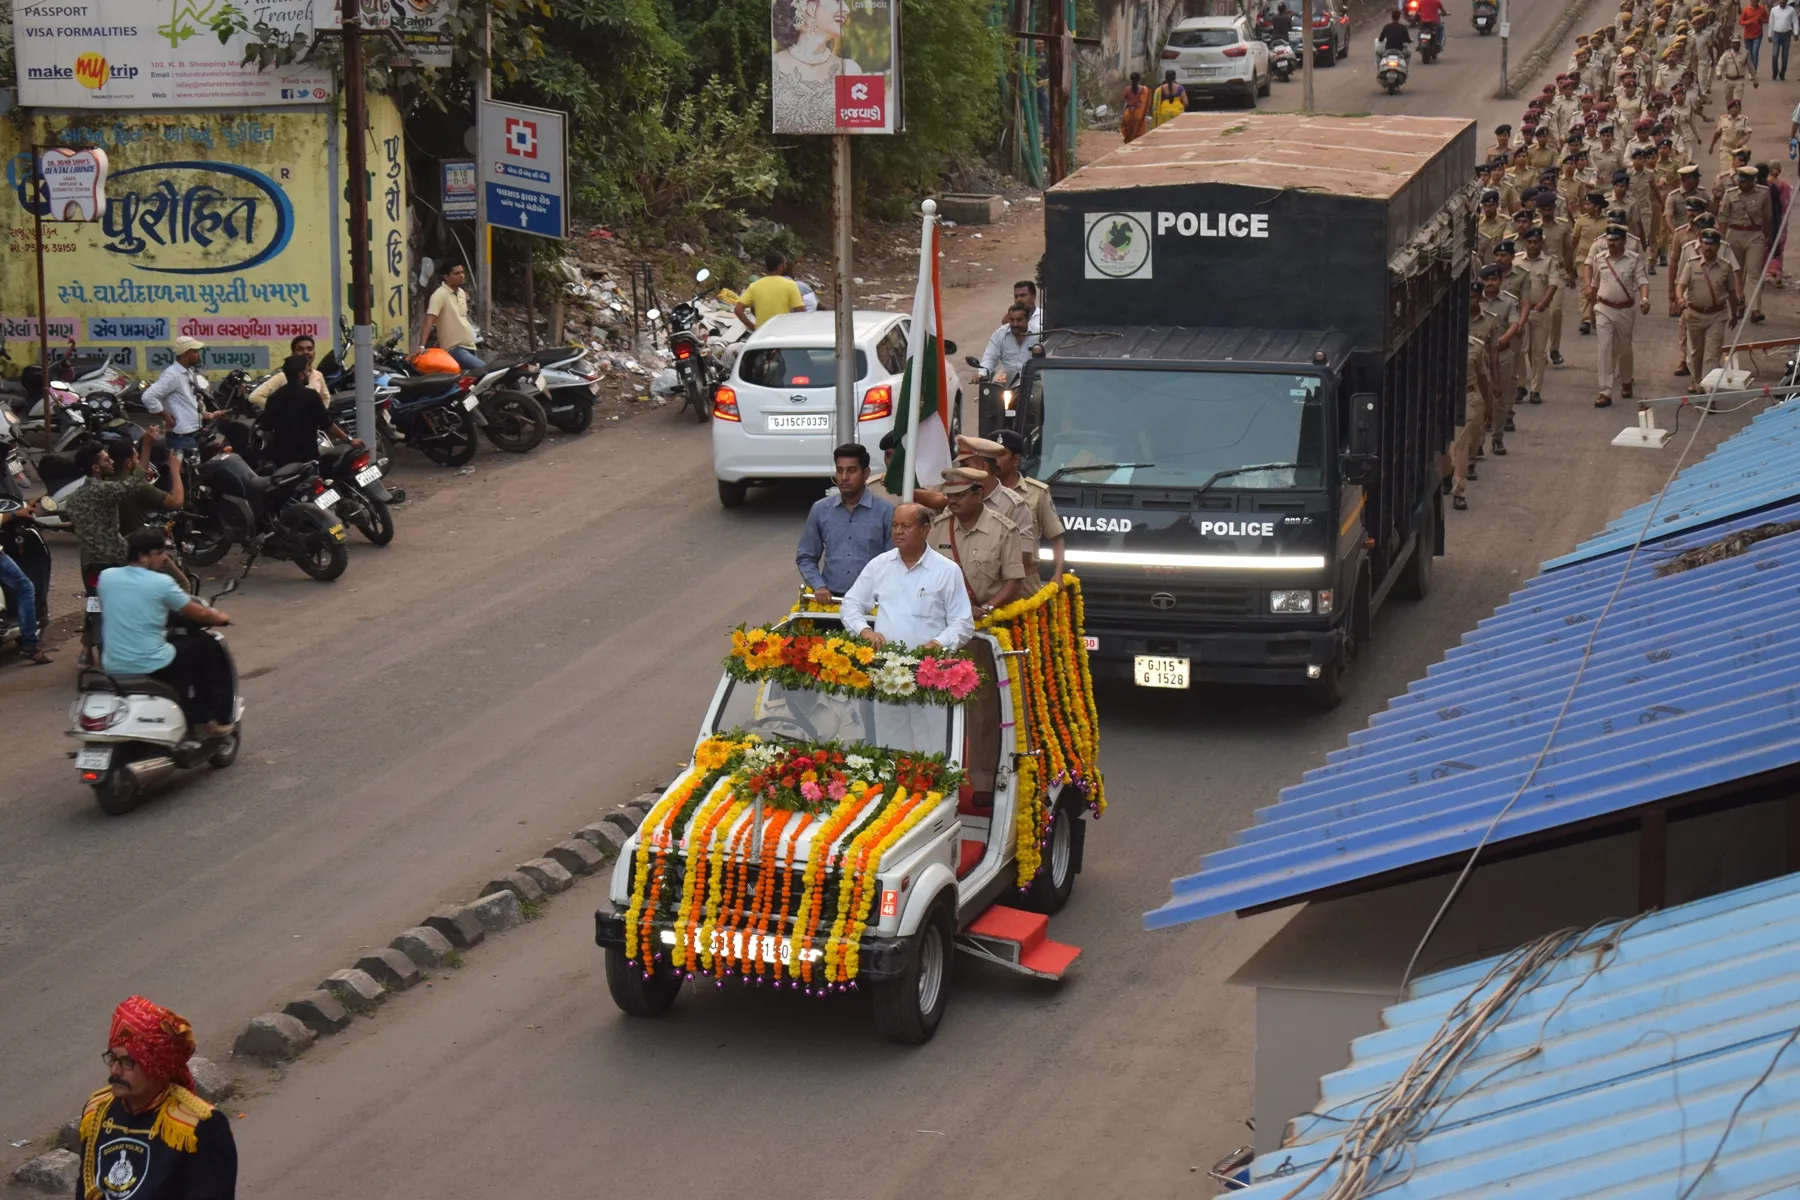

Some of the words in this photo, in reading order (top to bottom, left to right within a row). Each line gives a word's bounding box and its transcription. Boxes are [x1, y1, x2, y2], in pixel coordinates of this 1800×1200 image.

[25, 6, 88, 17] PASSPORT
[26, 27, 54, 37] VISA
[57, 26, 137, 37] FORMALITIES
[189, 61, 226, 69] Shopping
[28, 64, 73, 79] make
[76, 57, 106, 90] my
[110, 64, 139, 79] trip
[45, 166, 69, 174] DENTAL
[69, 165, 95, 173] LOUNGE
[281, 167, 290, 180] R
[496, 188, 520, 199] વલસાડ
[1157, 211, 1269, 238] POLICE
[251, 282, 310, 308] ખમણ
[93, 319, 117, 336] સેવ
[120, 318, 165, 340] ખમણી
[182, 319, 213, 336] તીખા
[217, 319, 271, 339] લસણીયા
[211, 354, 255, 367] ખમણ
[774, 417, 828, 427] GJ15CF0339
[1063, 516, 1132, 532] VALSAD
[1200, 521, 1274, 537] POLICE
[1147, 660, 1175, 672] GJ15
[1144, 672, 1150, 683] G
[1158, 673, 1184, 685] 1528
[887, 892, 895, 902] P
[883, 905, 895, 915] 48
